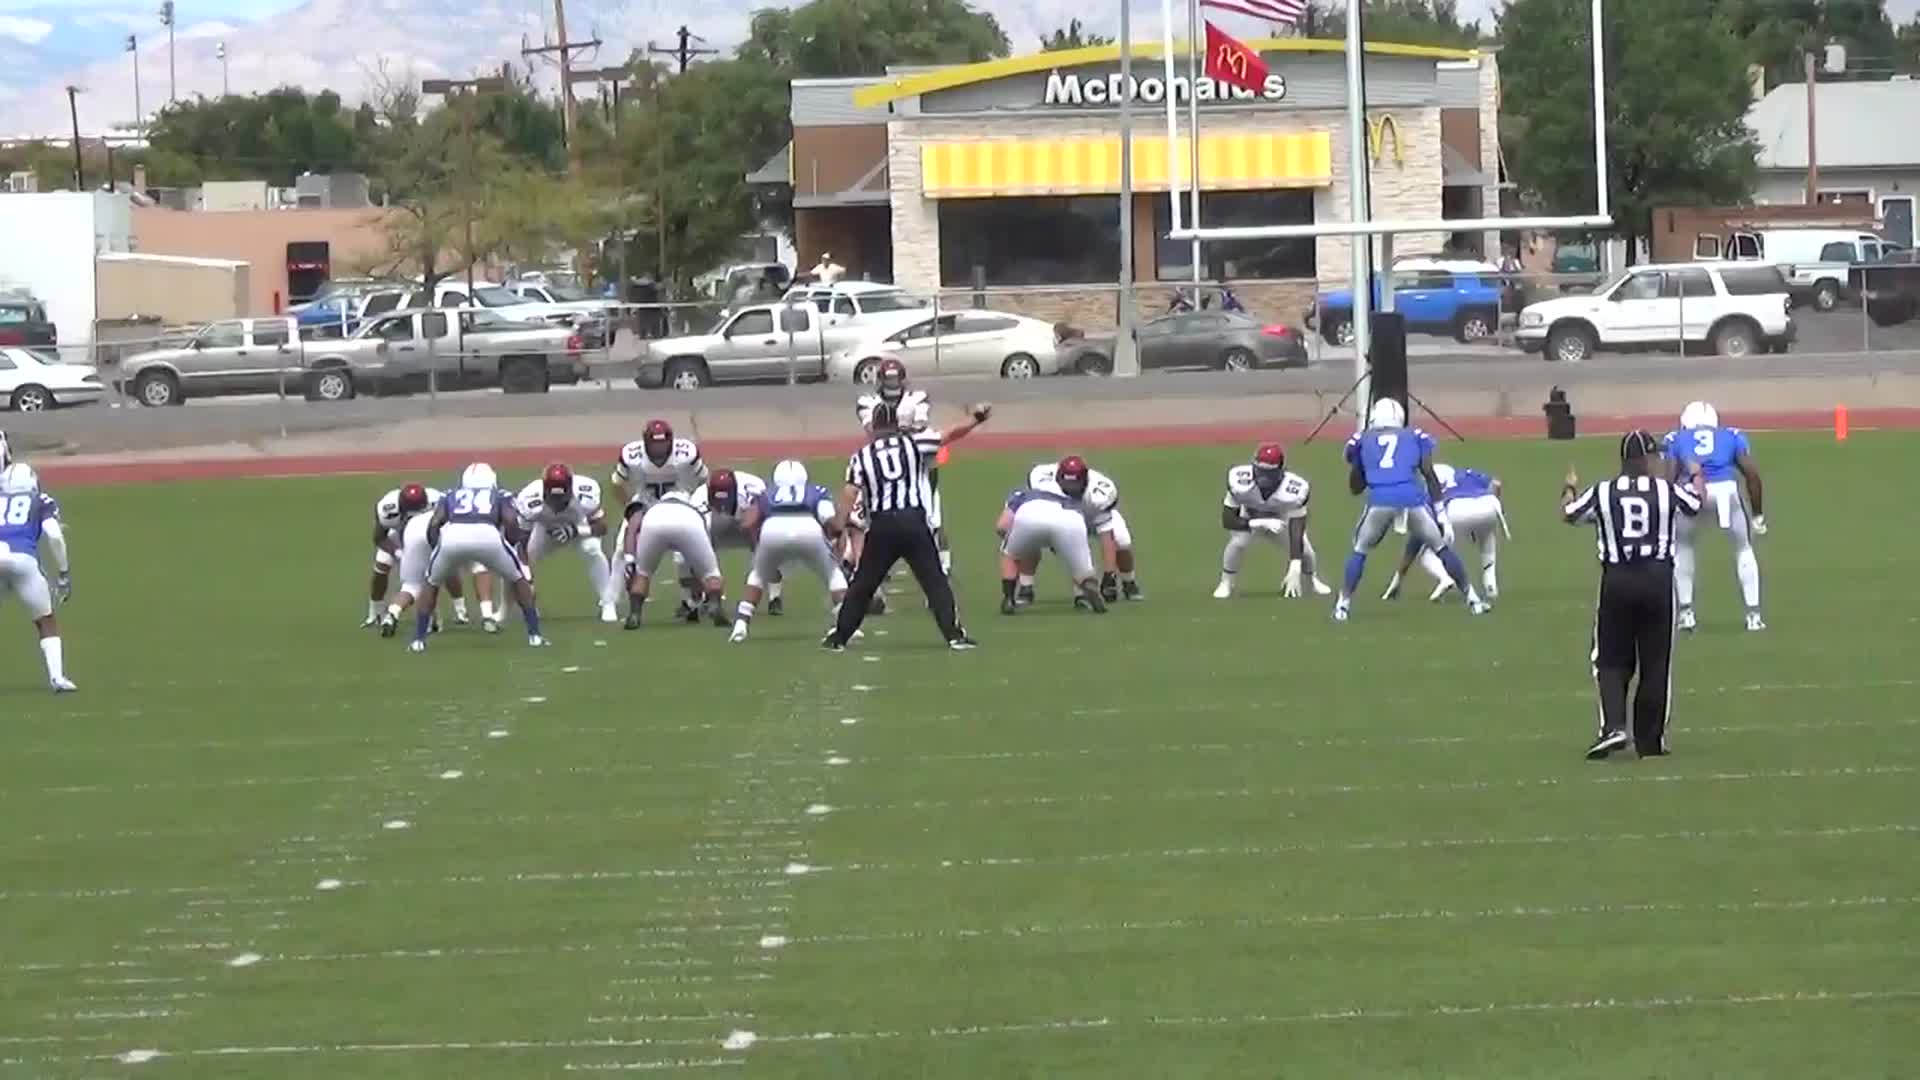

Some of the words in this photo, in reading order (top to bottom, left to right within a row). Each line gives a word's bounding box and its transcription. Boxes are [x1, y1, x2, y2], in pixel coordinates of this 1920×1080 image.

[1045, 72, 1286, 104] McDonals
[1378, 434, 1398, 468] 7
[1693, 430, 1714, 456] 3
[876, 446, 903, 480] U
[1620, 497, 1650, 538] B
